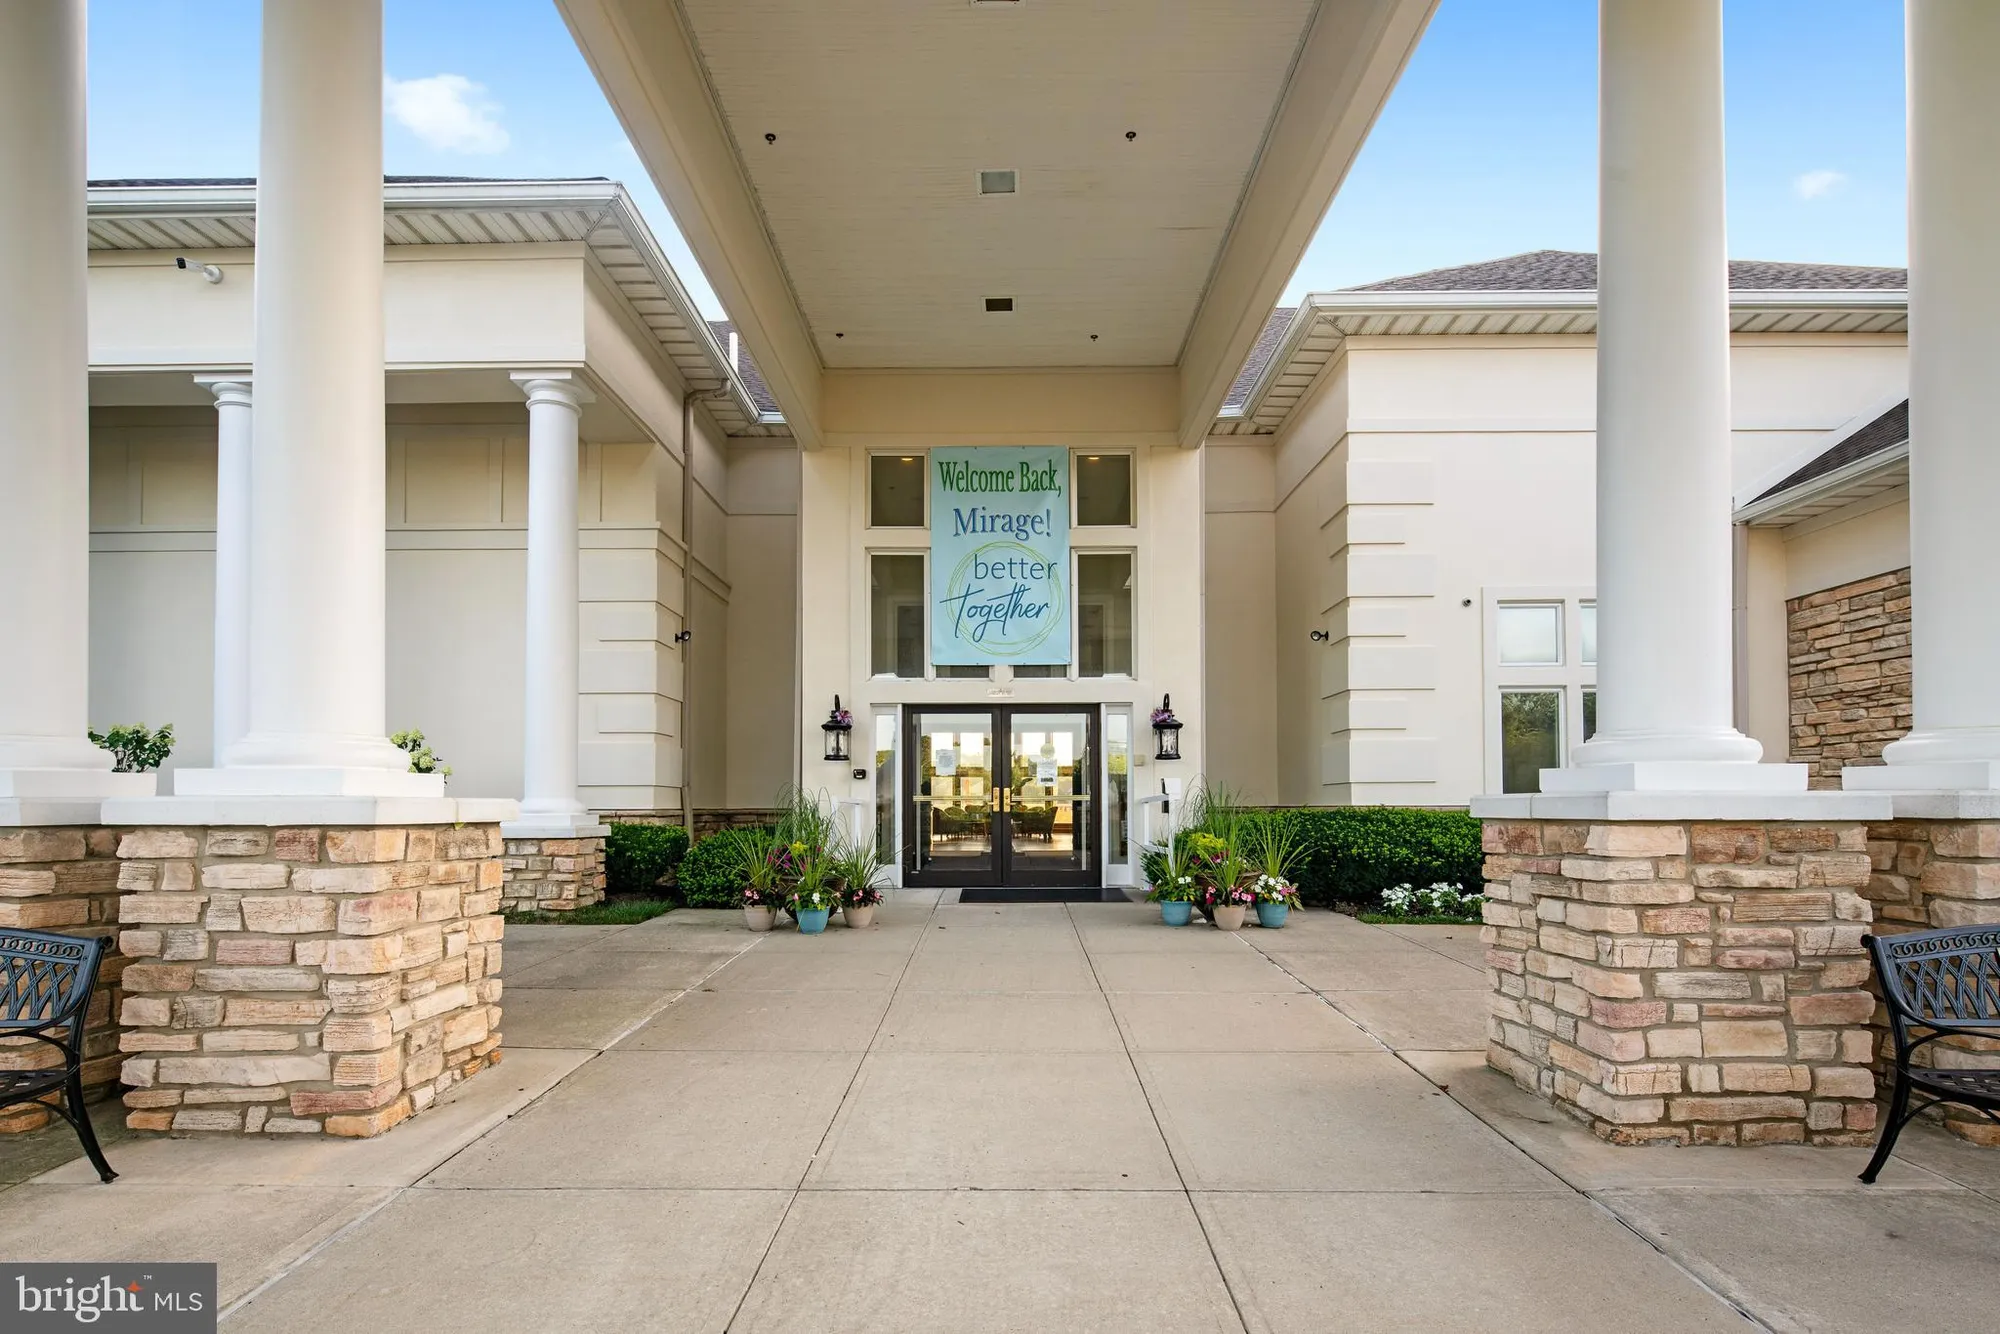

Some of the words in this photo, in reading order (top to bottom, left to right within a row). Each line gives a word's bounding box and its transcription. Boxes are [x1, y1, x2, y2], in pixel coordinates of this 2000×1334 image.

[938, 460, 1014, 493] Welcome
[1019, 459, 1062, 498] Back,
[953, 506, 1052, 541] Mirage!
[974, 554, 1058, 580] better
